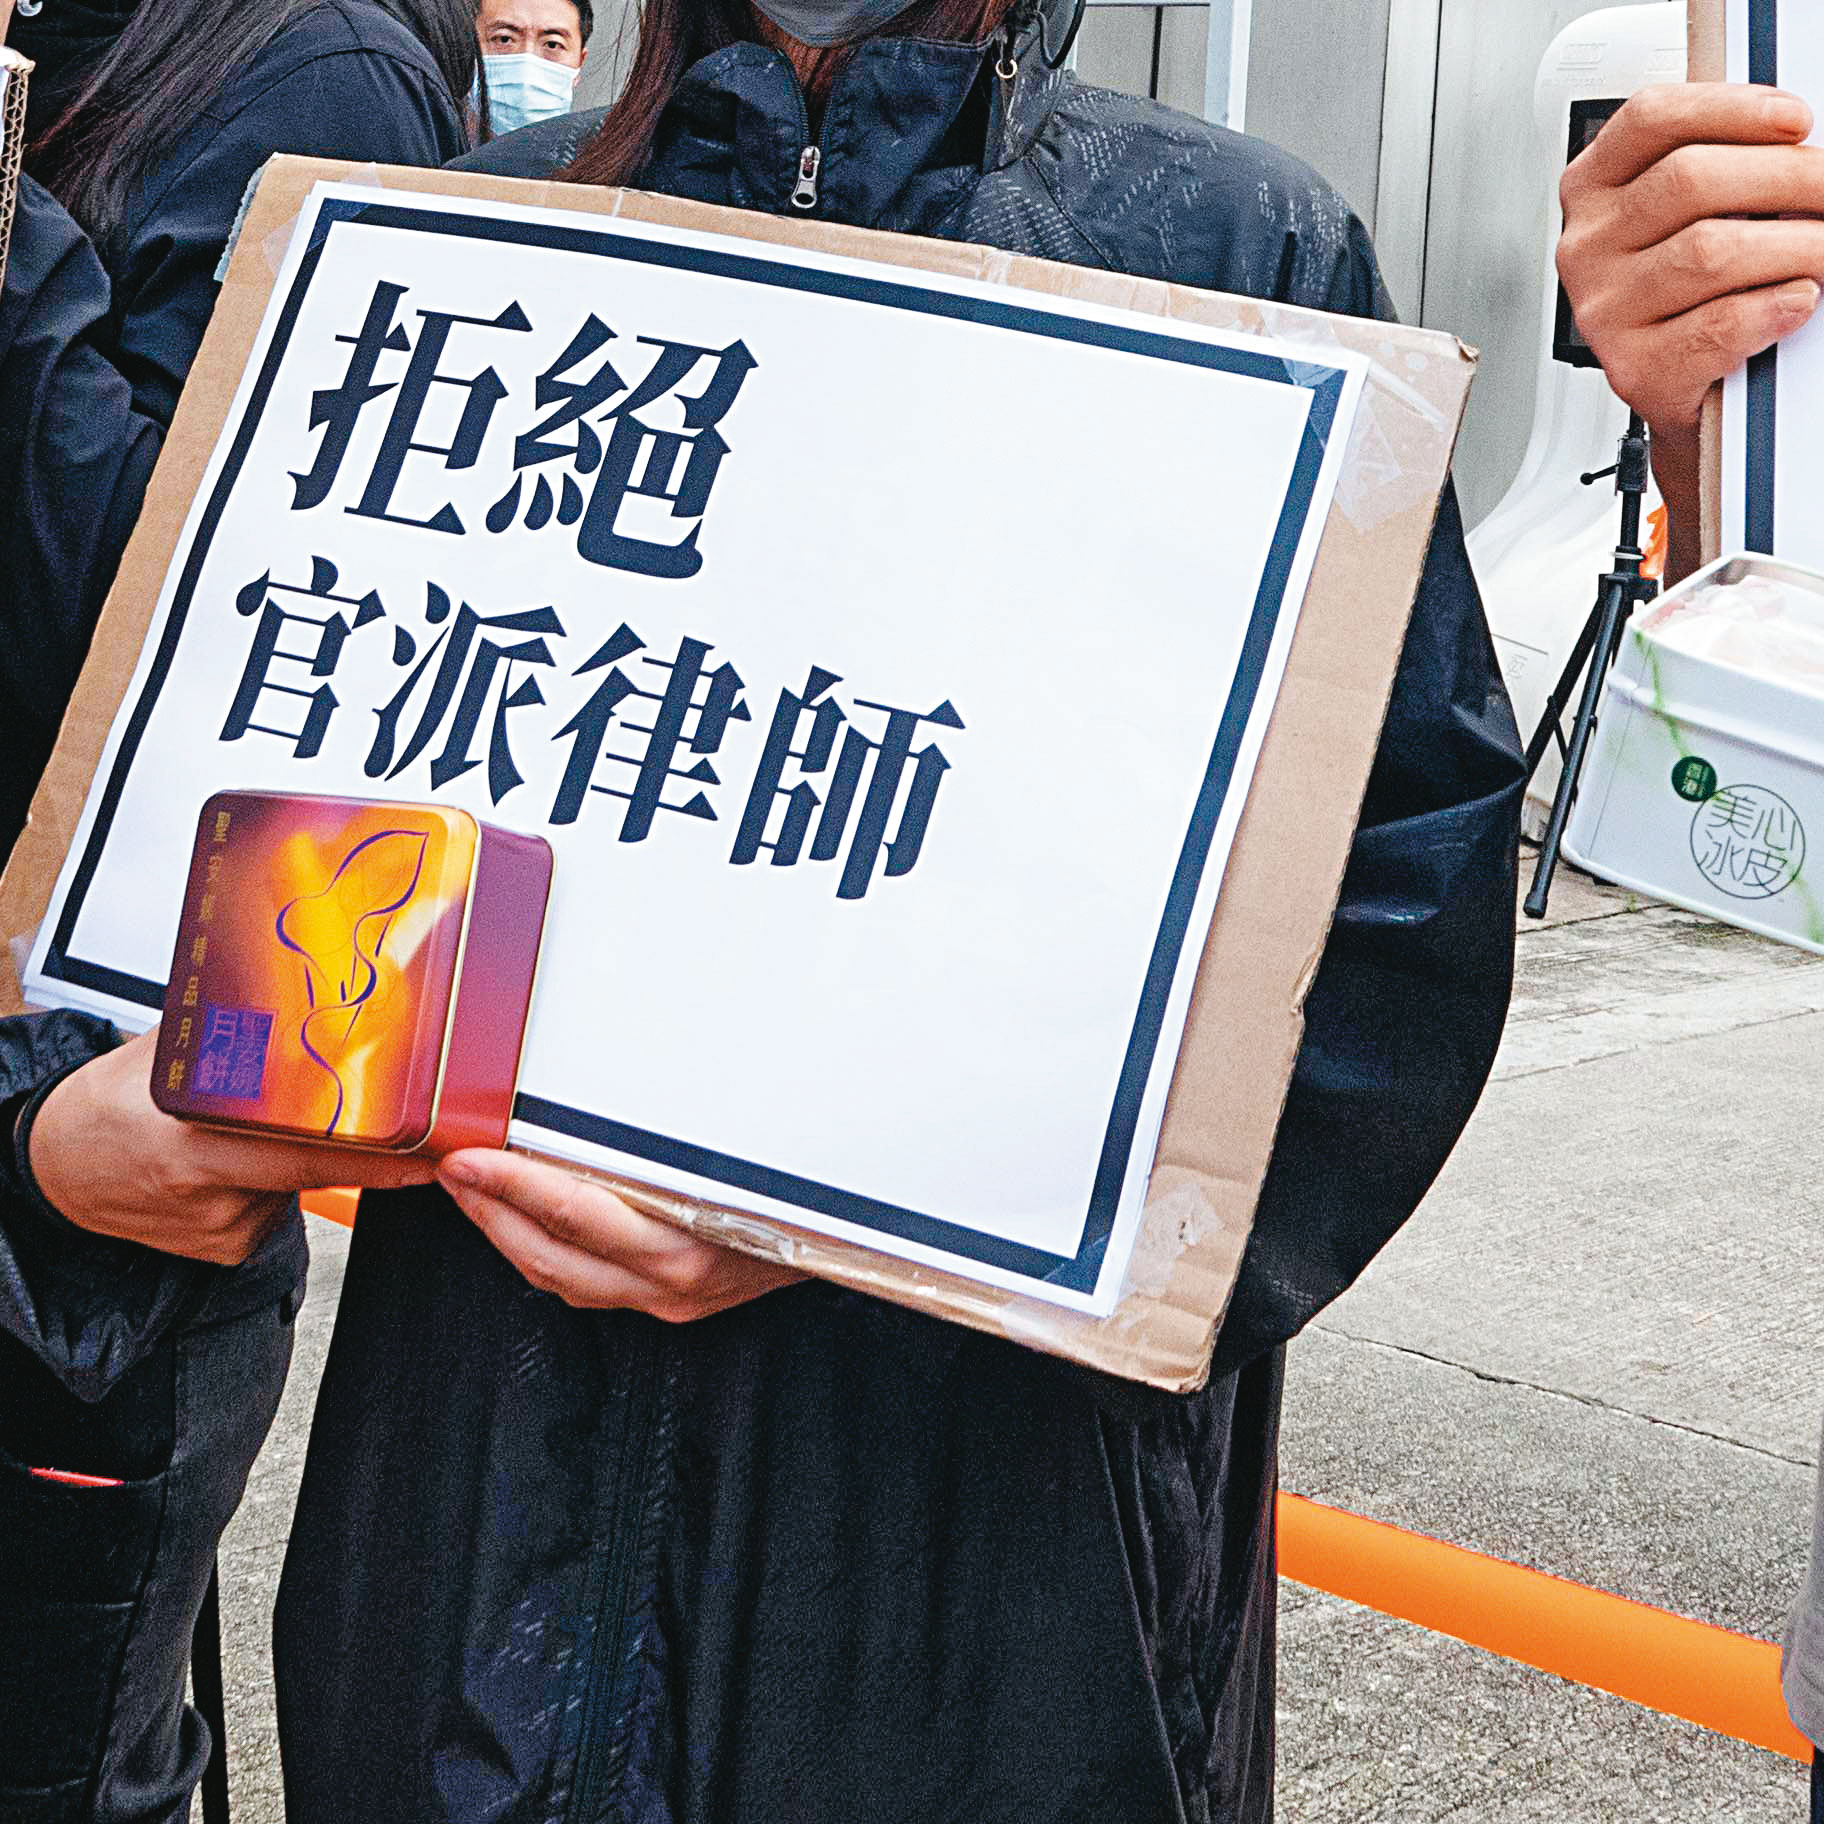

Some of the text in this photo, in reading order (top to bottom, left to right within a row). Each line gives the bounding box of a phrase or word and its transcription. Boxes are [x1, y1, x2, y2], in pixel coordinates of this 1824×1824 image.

[286, 279, 760, 579] 拒絕
[218, 555, 967, 900] 官派律師
